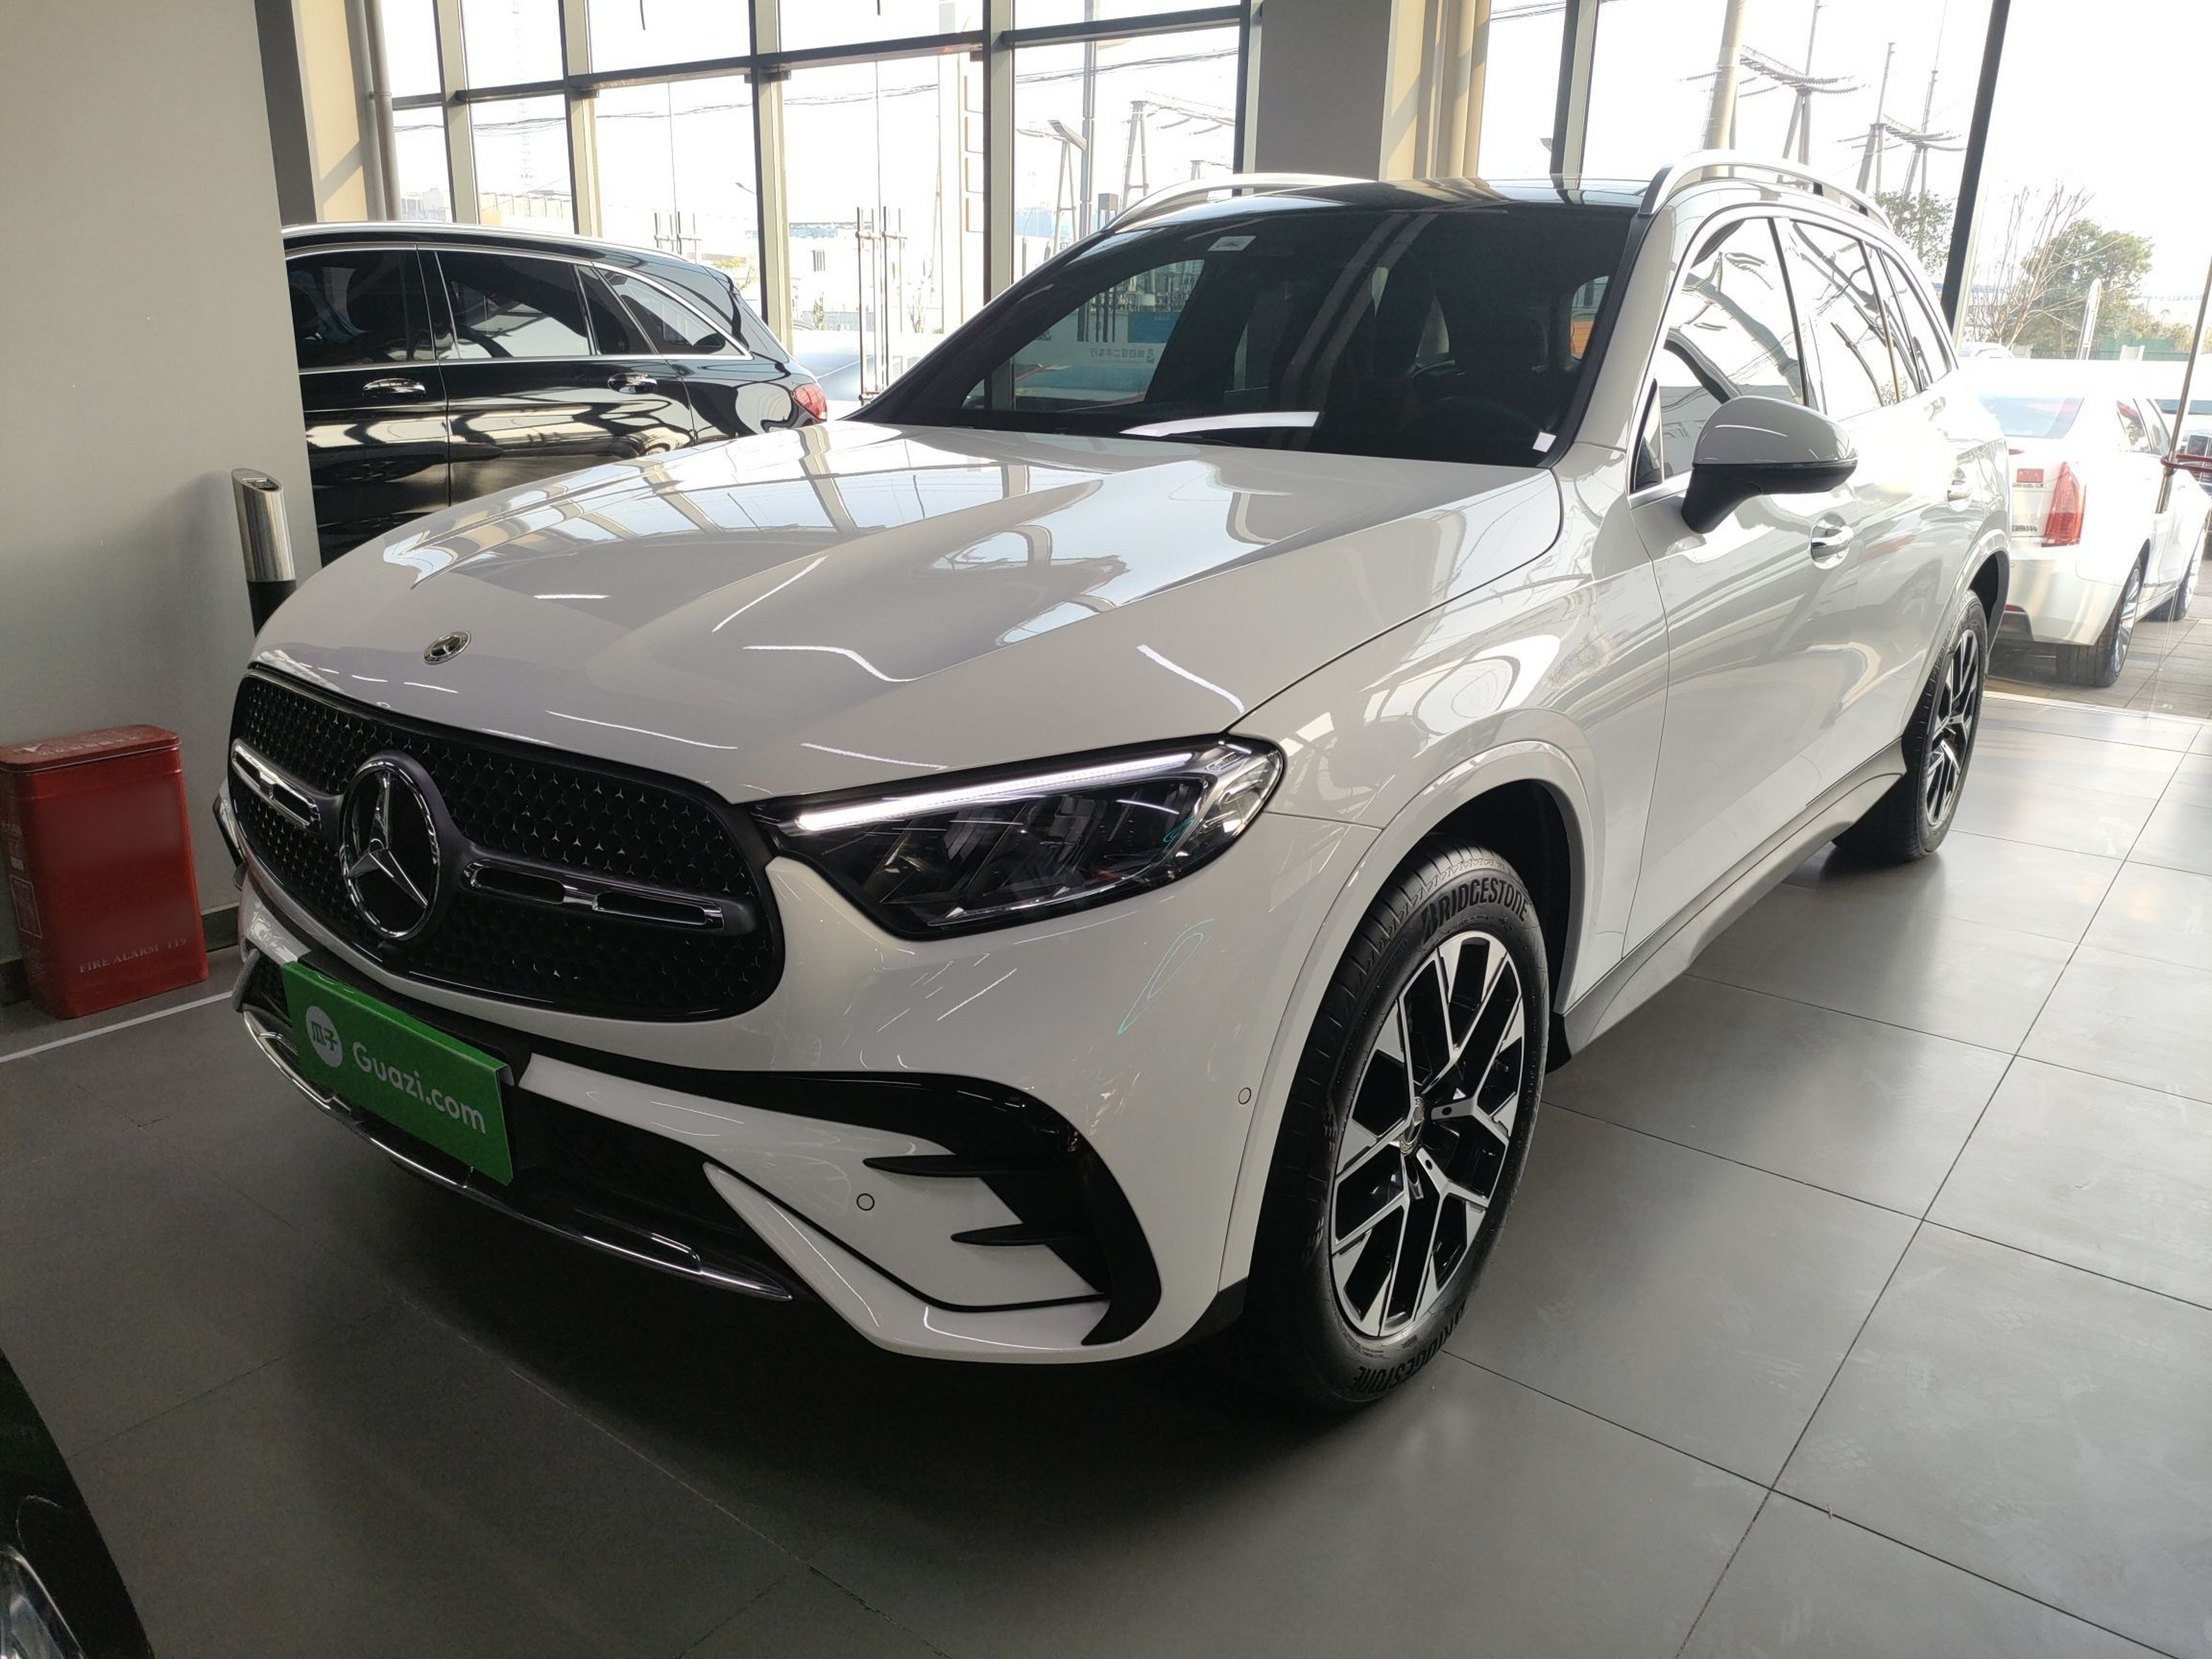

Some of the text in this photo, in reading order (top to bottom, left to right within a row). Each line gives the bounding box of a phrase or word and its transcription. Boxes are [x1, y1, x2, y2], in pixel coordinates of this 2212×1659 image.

[1421, 877, 1528, 944] BRIDGESTONE
[79, 937, 187, 973] FIRE ALARM 119
[353, 1041, 486, 1134] Guazi.com
